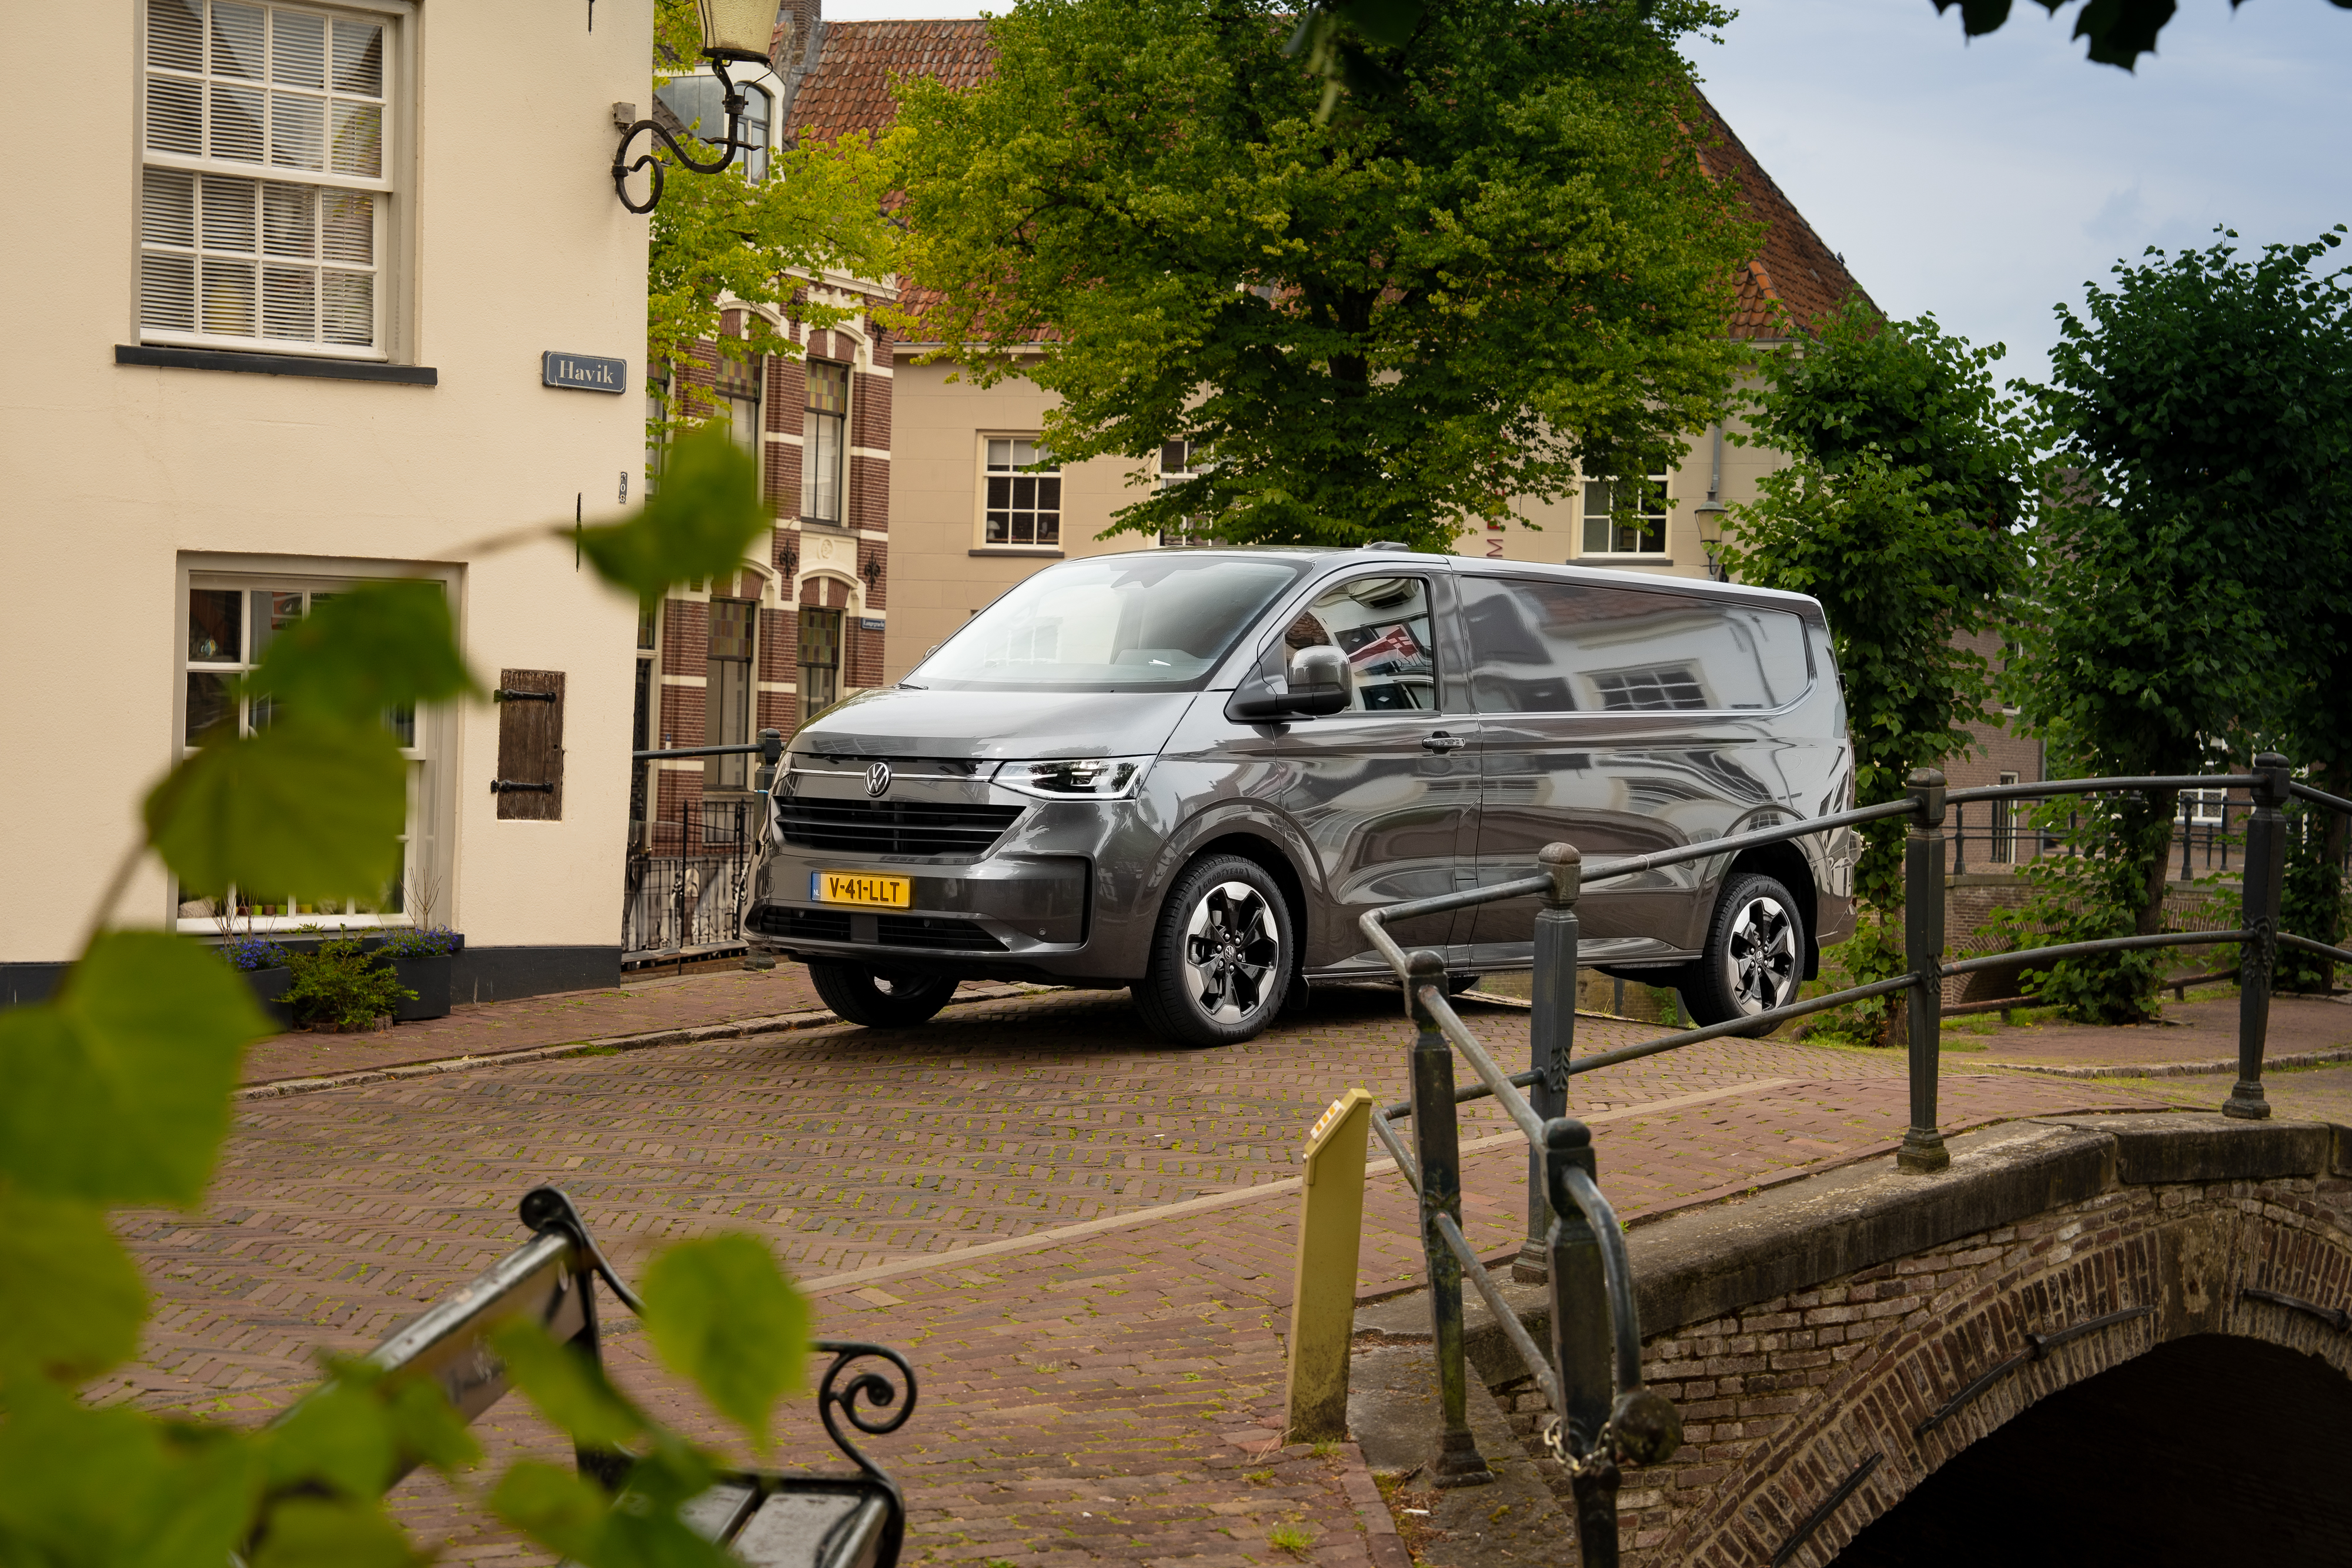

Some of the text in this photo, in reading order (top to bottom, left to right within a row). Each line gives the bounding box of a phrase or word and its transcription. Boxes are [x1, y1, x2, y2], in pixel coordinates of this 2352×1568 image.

[559, 360, 614, 384] Havik
[865, 763, 888, 795] VW
[830, 877, 900, 902] V-41-LLT
[1203, 868, 1244, 889] GOODYEAR
